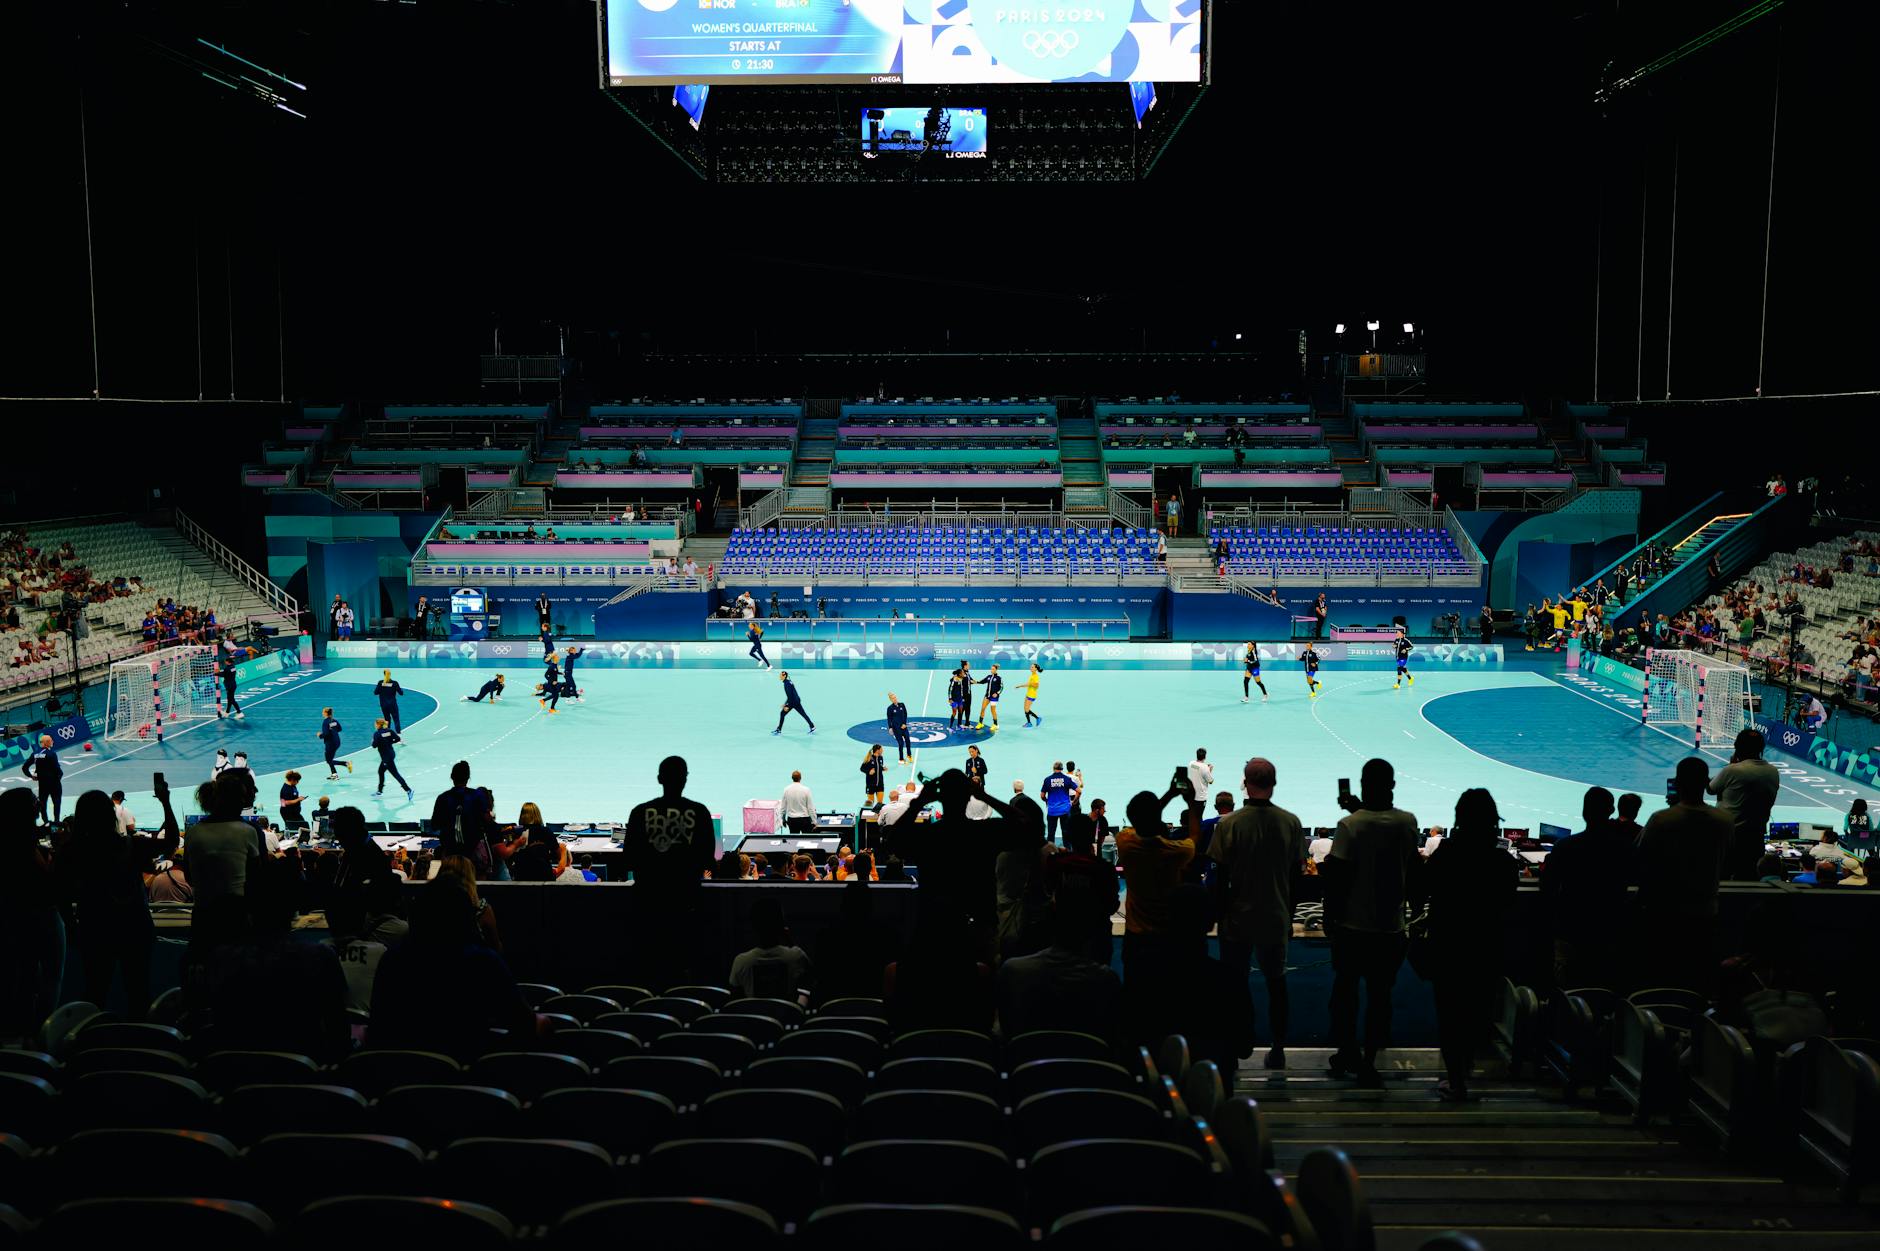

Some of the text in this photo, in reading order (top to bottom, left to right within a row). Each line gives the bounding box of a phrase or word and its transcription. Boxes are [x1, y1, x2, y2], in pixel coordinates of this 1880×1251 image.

[713, 0, 736, 9] NOR
[996, 9, 1105, 23] PARIS 2024
[692, 22, 818, 33] WOMEN'S QUARTERFINAL
[729, 41, 781, 51] STARTS AT
[746, 59, 774, 70] 21:30
